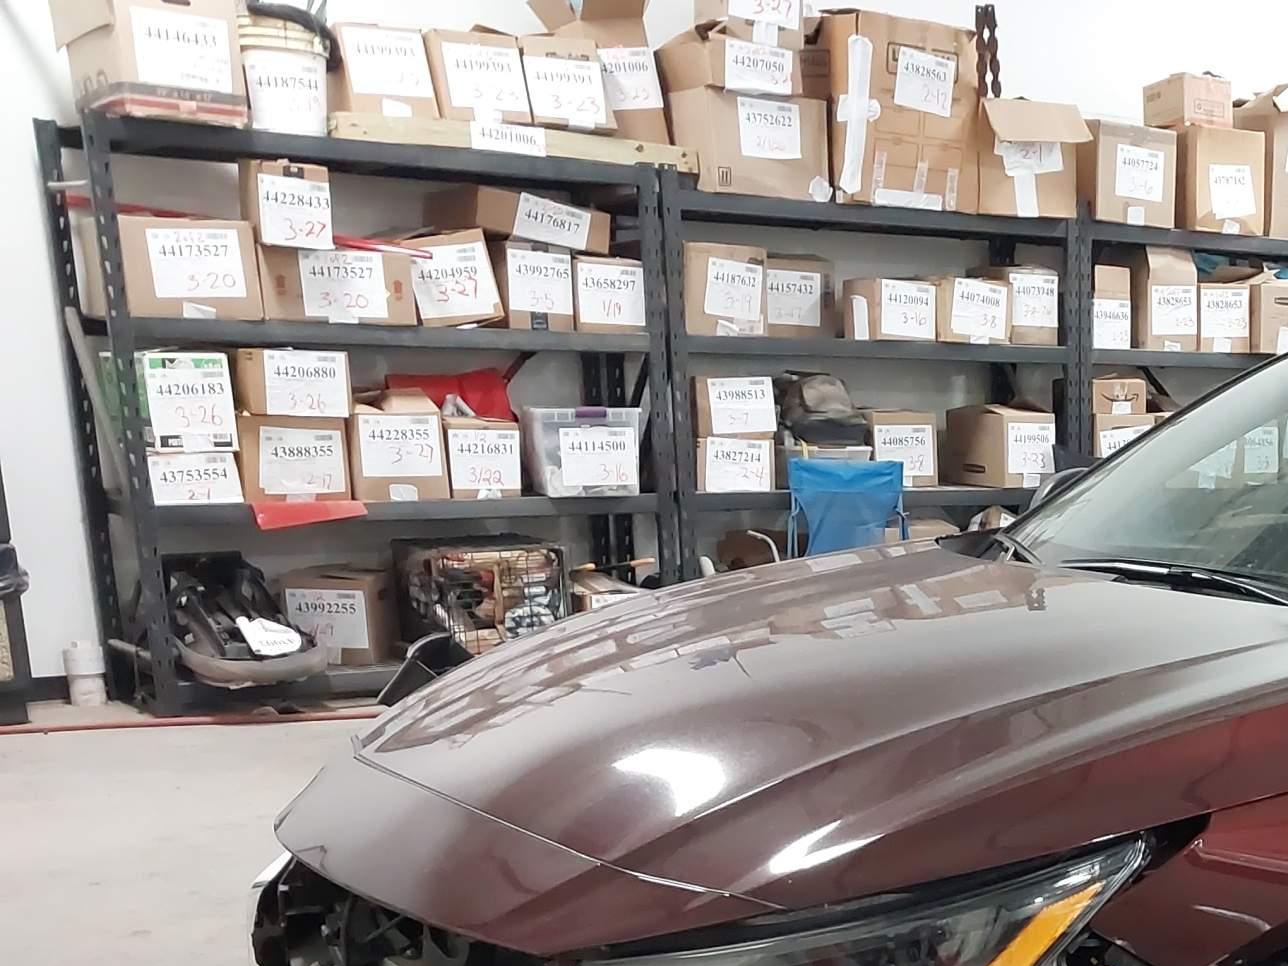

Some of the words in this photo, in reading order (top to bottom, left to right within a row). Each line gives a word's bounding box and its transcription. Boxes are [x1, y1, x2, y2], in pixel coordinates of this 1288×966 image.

[600, 61, 649, 74] 4201006
[732, 54, 785, 73] 44207050
[745, 112, 793, 128] 43752622
[262, 189, 331, 210] 44228433
[523, 208, 580, 235] 44176817
[158, 244, 229, 258] 44173527
[308, 266, 374, 280] 44173527
[417, 265, 478, 282] 44204959
[515, 264, 570, 280] 43992765
[713, 271, 757, 288] 44187632
[582, 276, 636, 291] 43658297
[768, 280, 814, 295] 44157432
[887, 292, 929, 307] 44120094
[959, 289, 1001, 308] 44074008
[273, 364, 336, 380] 44206880
[155, 382, 225, 397] 44206183
[715, 388, 766, 401] 43988513
[368, 428, 431, 442] 44228355
[881, 436, 926, 448] 44085756
[1013, 432, 1050, 445] 44199506
[270, 444, 334, 459] 43888355
[456, 442, 514, 456] 44216831
[567, 439, 626, 452] 44114500
[713, 449, 761, 464] 43827214
[159, 467, 228, 484] 43753554
[295, 601, 357, 615] 43992255
